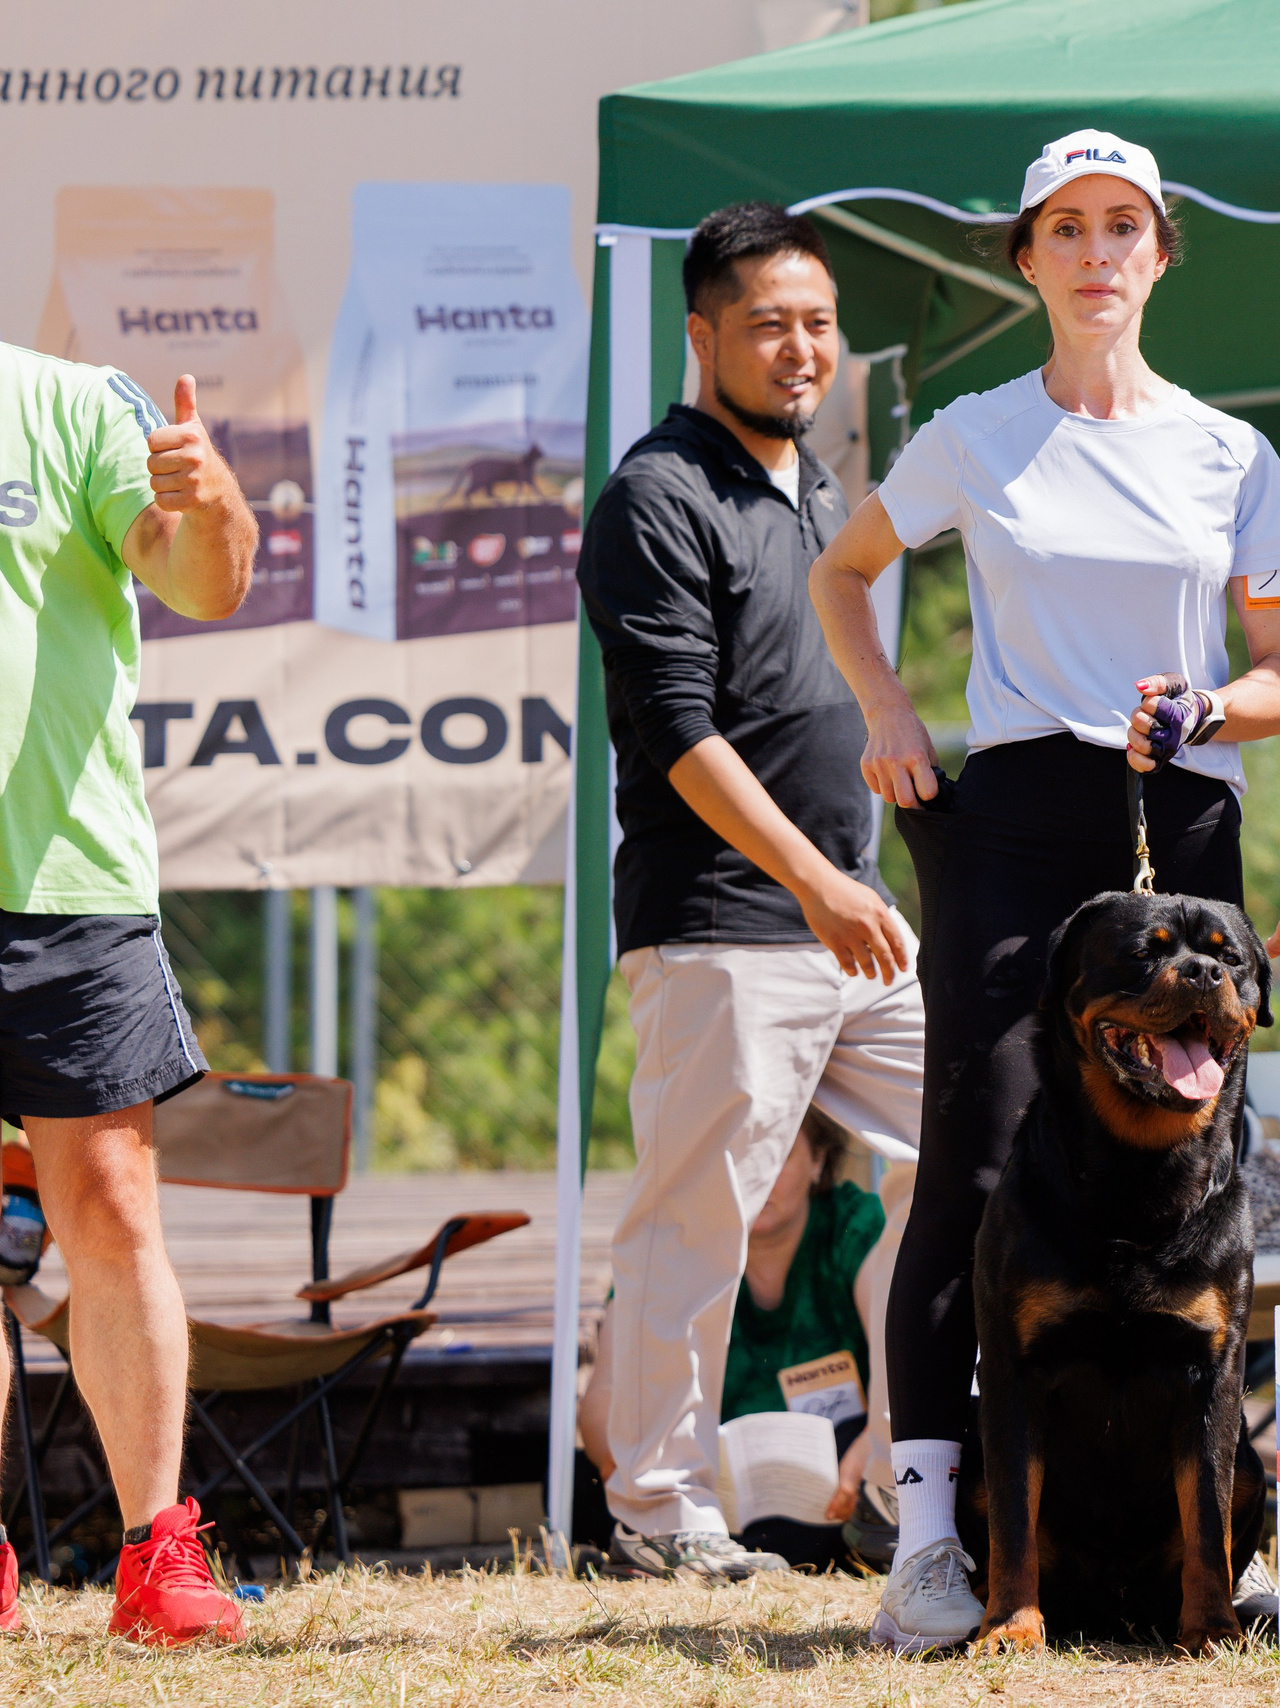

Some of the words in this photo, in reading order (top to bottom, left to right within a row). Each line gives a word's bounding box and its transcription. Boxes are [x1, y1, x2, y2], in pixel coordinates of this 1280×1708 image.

[195, 64, 462, 101] питания
[1065, 149, 1126, 165] FILA
[118, 306, 258, 334] Hanta
[415, 304, 555, 332] Hanta
[346, 436, 366, 610] Hanta
